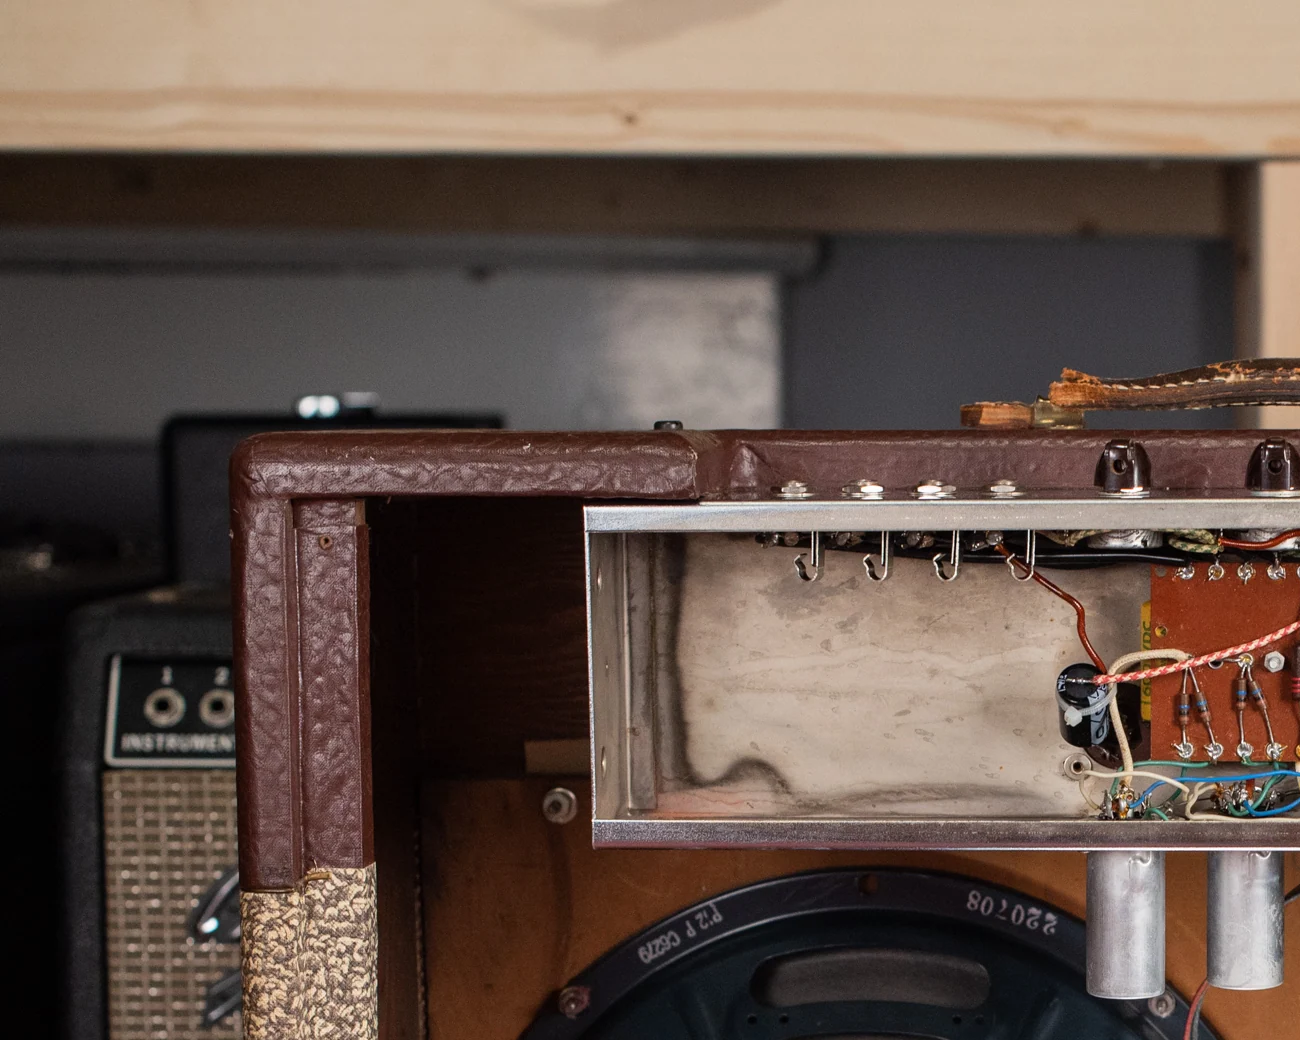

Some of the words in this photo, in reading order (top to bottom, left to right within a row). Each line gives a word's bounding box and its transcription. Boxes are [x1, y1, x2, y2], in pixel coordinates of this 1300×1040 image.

[161, 666, 173, 685] 1
[214, 666, 230, 686] 2
[121, 733, 235, 751] INSTRUMEN
[967, 889, 1058, 935] 220708
[685, 919, 697, 938] P
[638, 933, 681, 964] C6279
